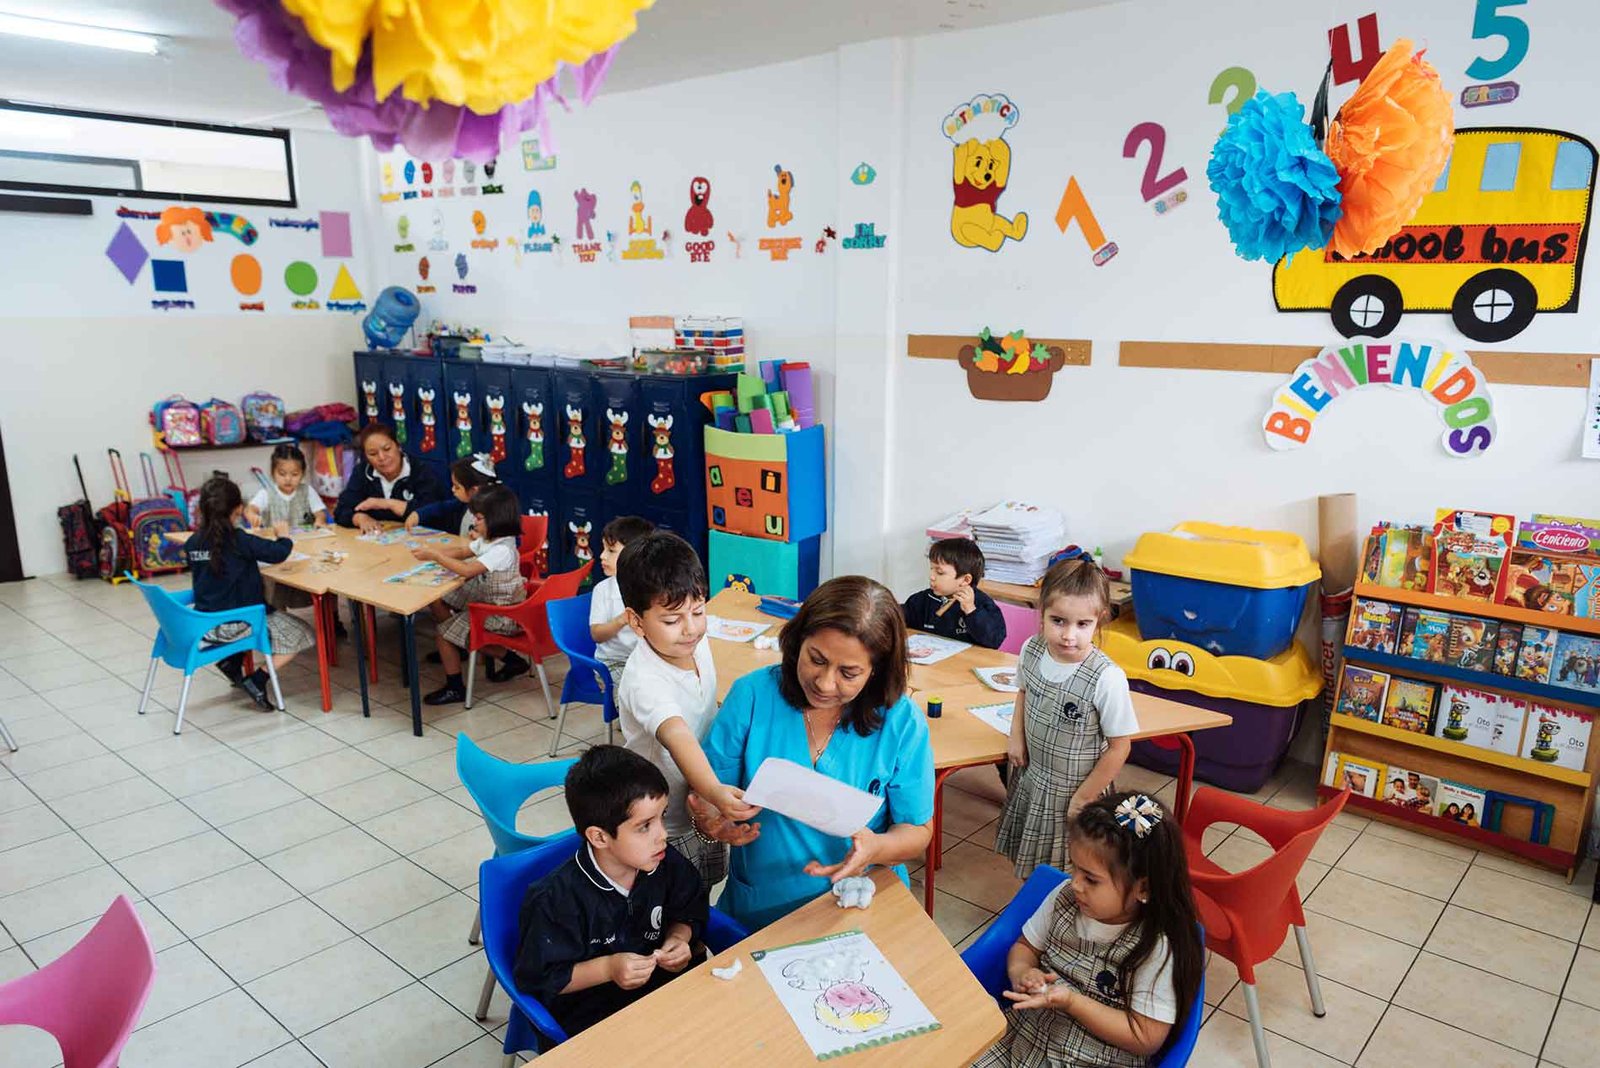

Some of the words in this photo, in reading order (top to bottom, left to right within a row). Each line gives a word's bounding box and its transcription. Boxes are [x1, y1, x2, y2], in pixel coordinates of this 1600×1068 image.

[1328, 13, 1386, 87] 4
[1464, 0, 1530, 81] 5
[1122, 121, 1189, 203] 2
[1054, 174, 1107, 252] 1
[572, 242, 602, 253] THANK
[685, 241, 715, 252] GOOD
[842, 235, 887, 249] SORRY
[1481, 225, 1569, 265] bus
[578, 252, 596, 263] YOU
[1265, 342, 1491, 454] BIENVENIDOS
[709, 467, 722, 486] a
[765, 471, 776, 491] i
[736, 488, 752, 507] e
[765, 514, 783, 535] u
